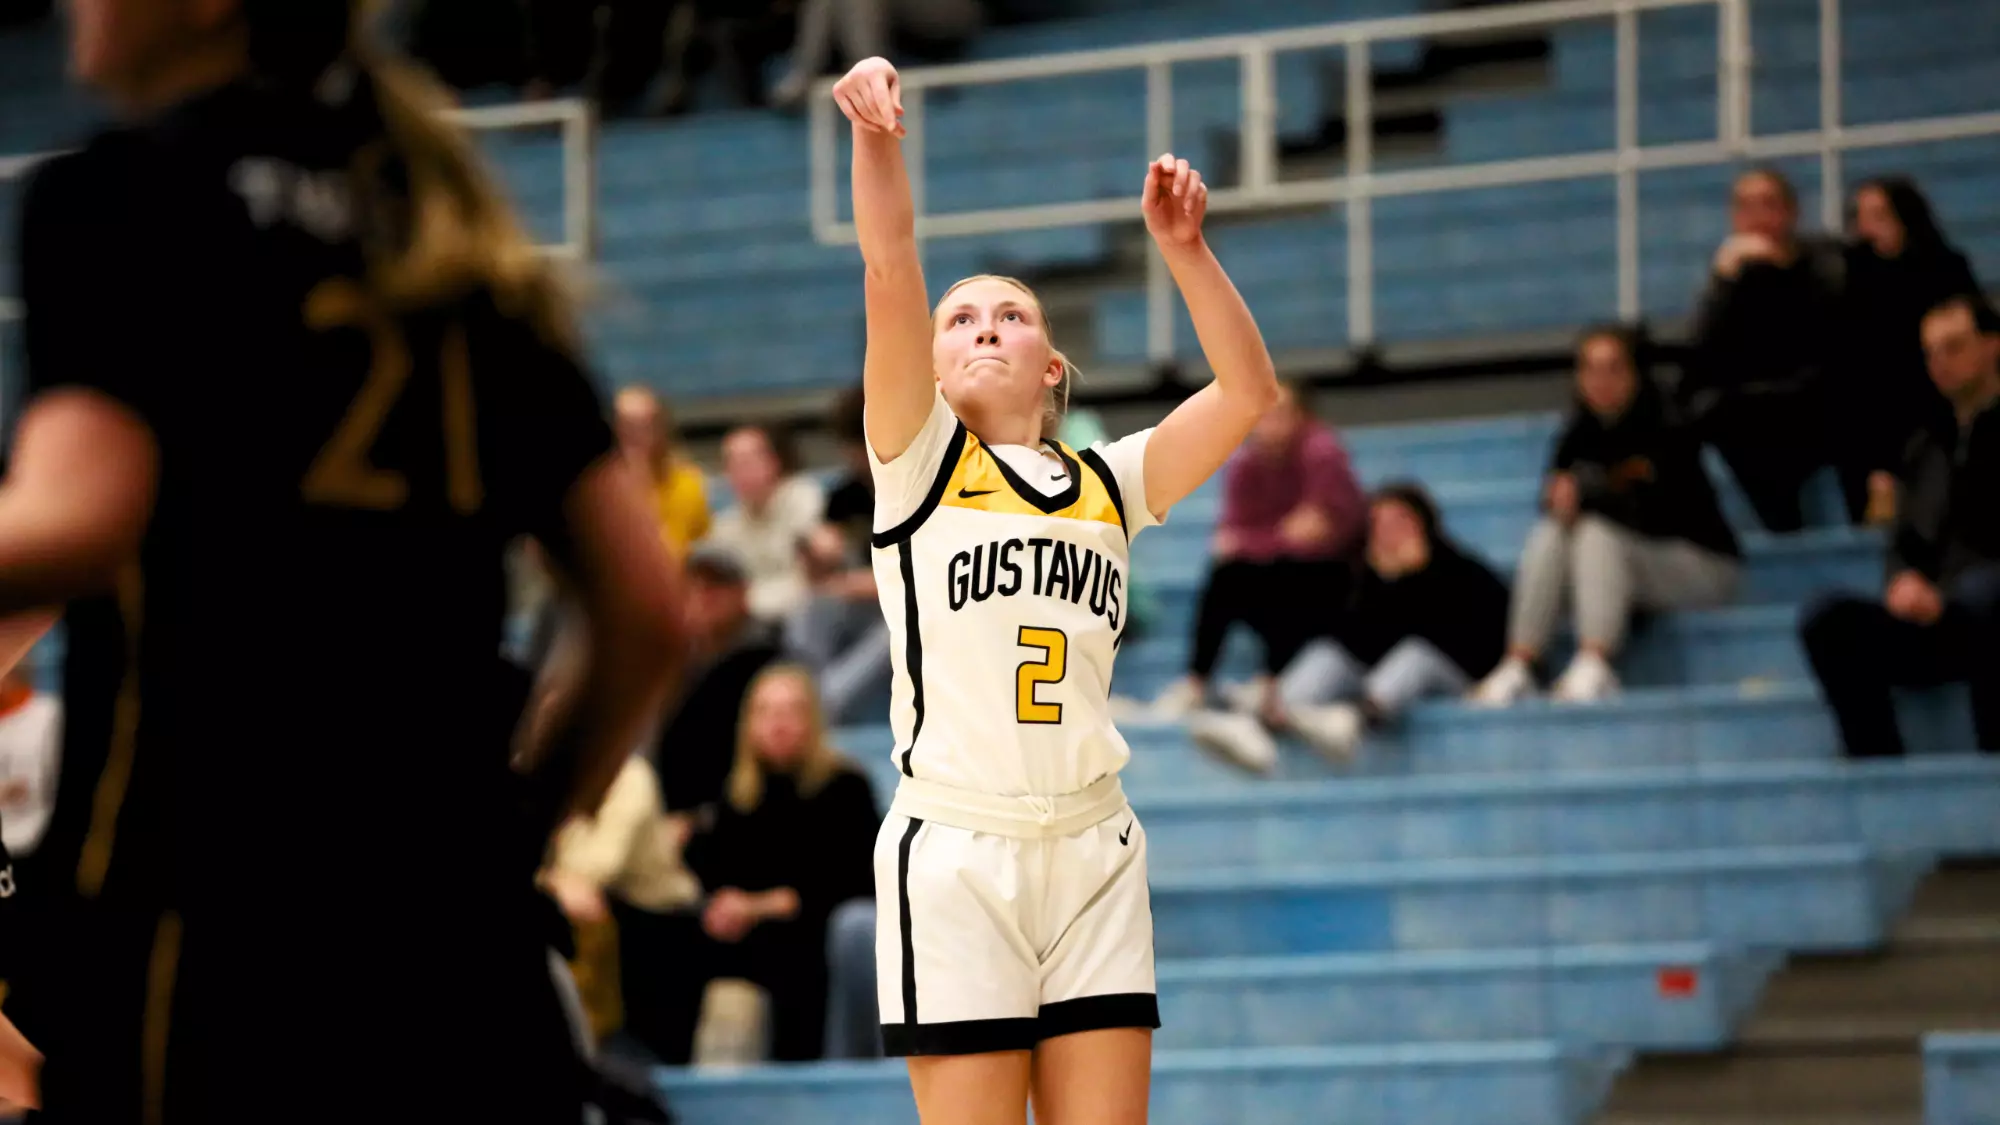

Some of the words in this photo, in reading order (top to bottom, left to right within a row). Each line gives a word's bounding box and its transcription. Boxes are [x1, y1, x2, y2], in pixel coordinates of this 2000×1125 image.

[301, 278, 483, 514] 21
[948, 537, 1122, 631] GUSTAVUS
[1016, 625, 1067, 724] 2
